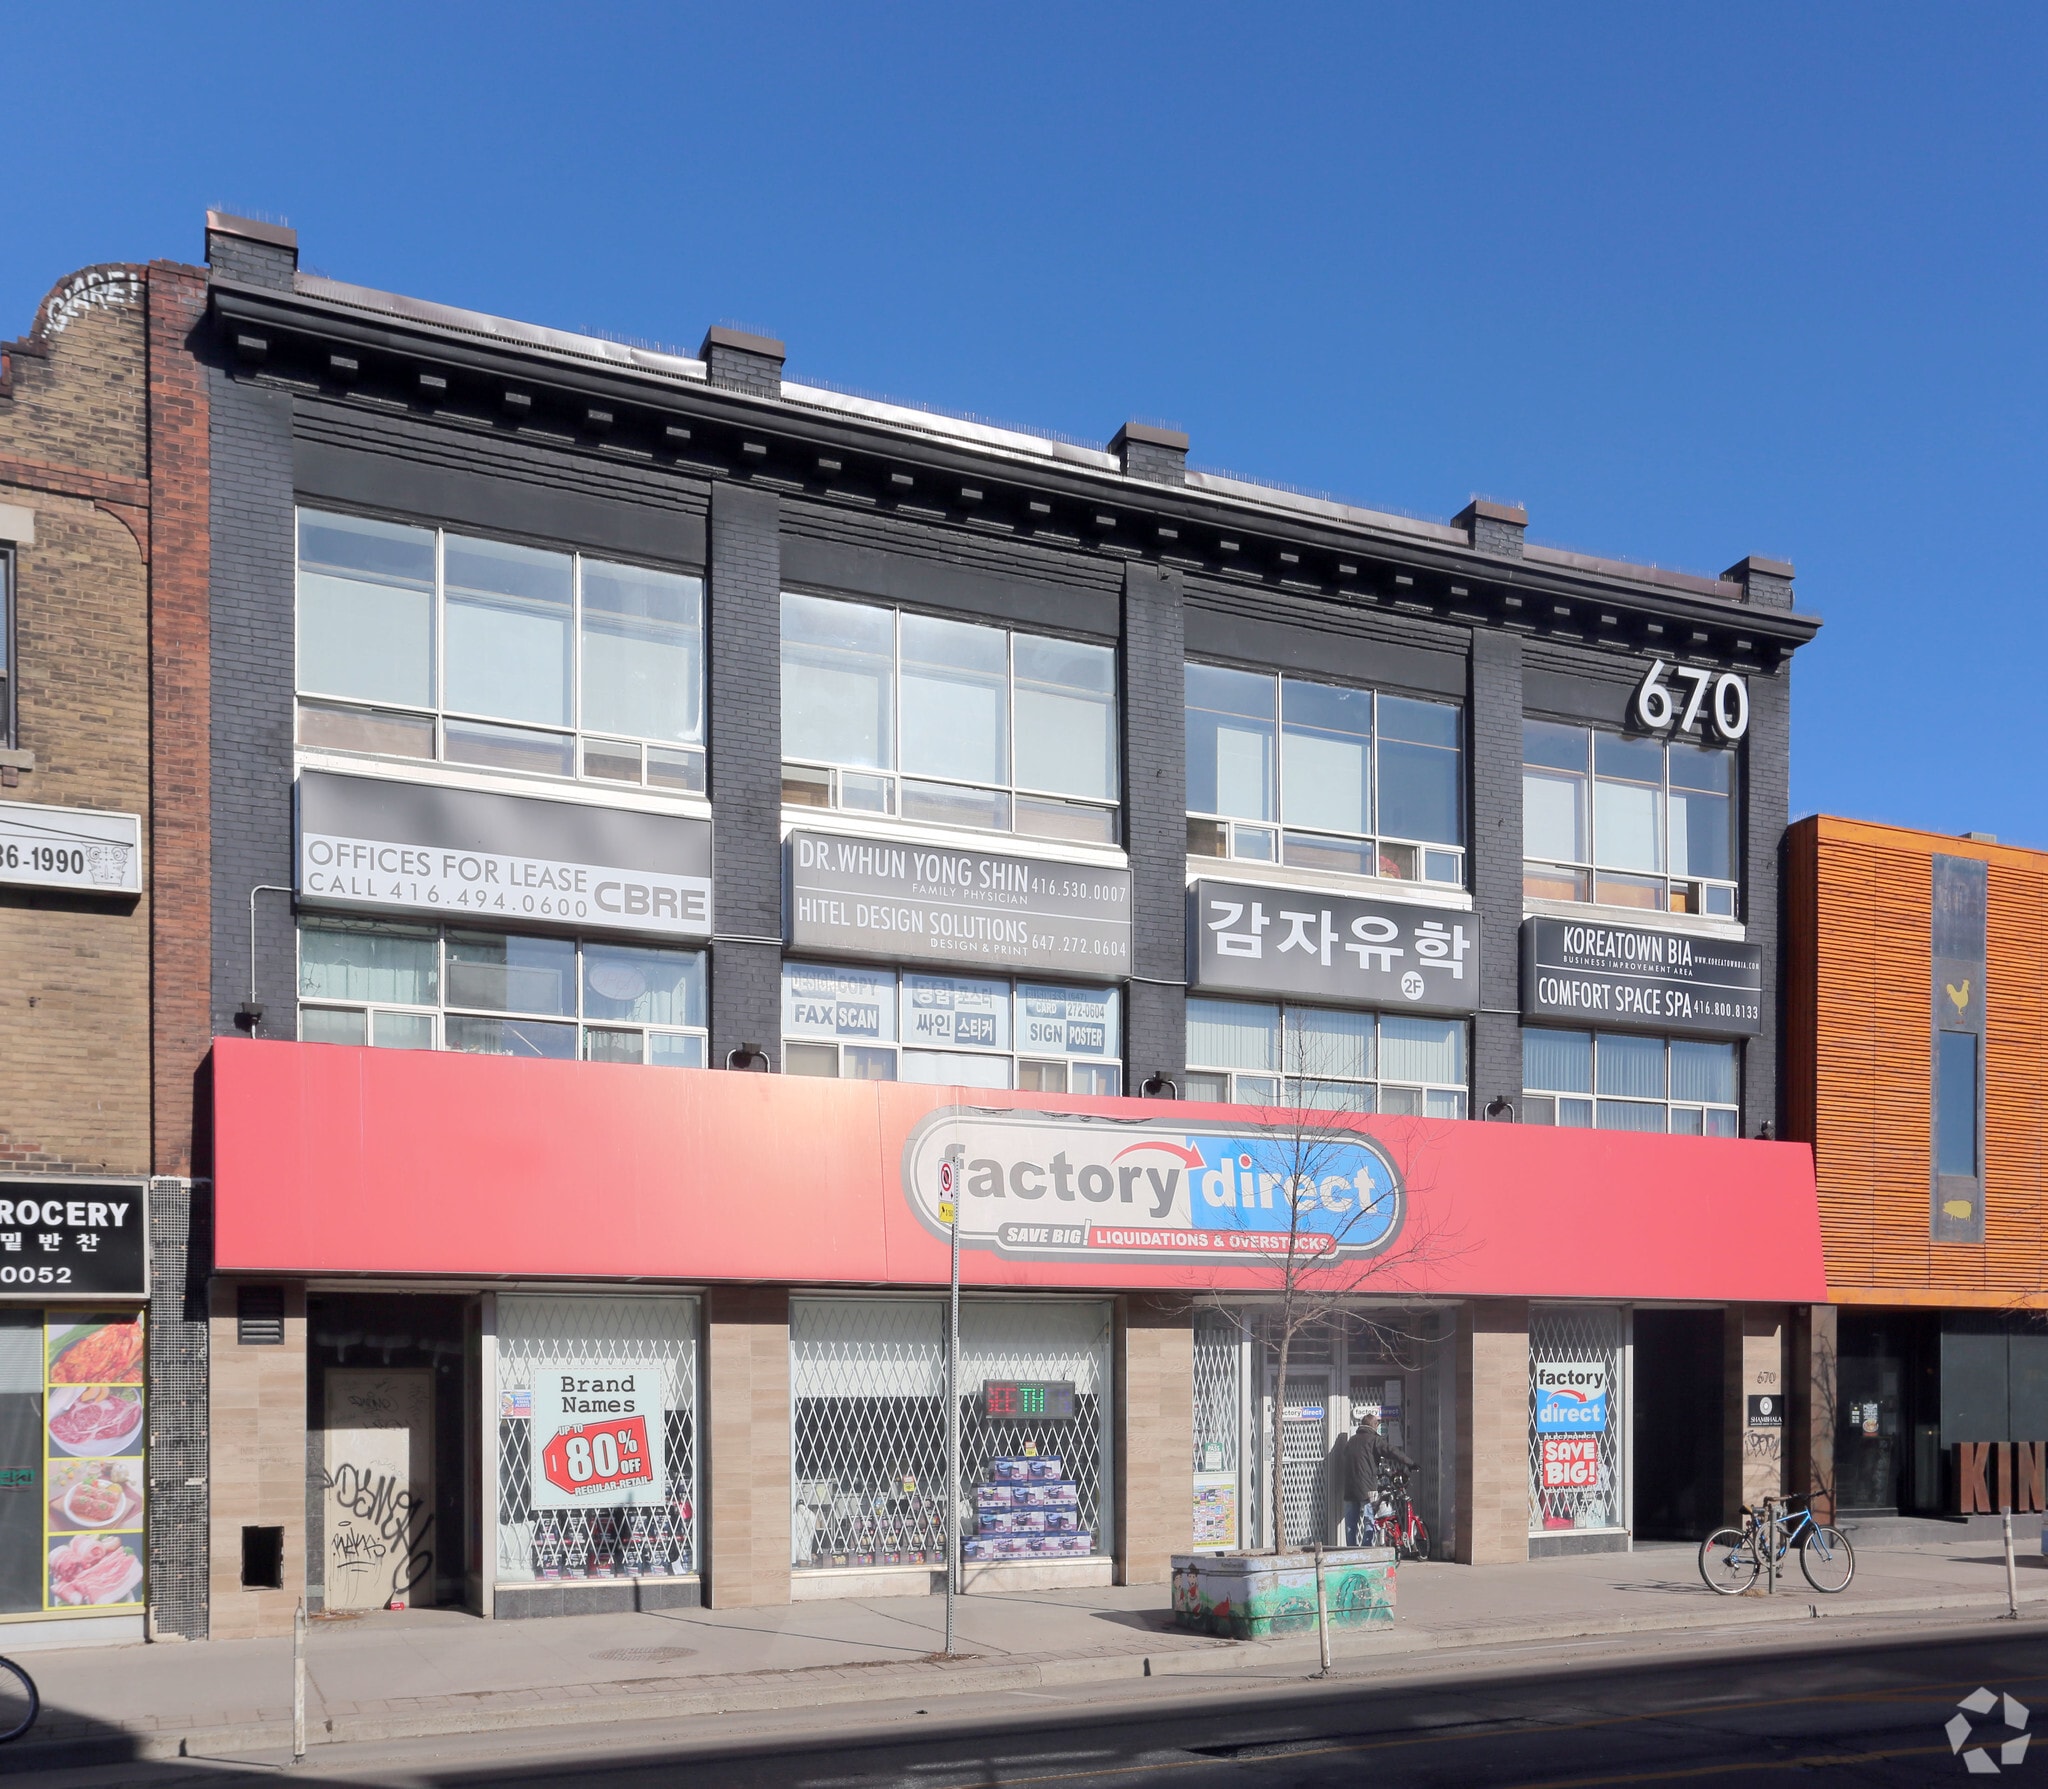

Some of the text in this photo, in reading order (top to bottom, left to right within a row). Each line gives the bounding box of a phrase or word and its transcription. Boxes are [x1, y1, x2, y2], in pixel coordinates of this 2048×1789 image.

[1639, 658, 1749, 739] 670
[308, 840, 587, 893] OFFICES FOR LEASE
[913, 852, 972, 887] YONG
[979, 861, 1028, 893] SHIN
[1032, 878, 1126, 902] 416.530.0007
[309, 872, 587, 918] CALL 416.494.0600
[594, 881, 706, 921] CBRE
[912, 883, 1028, 905] FAMILY PHYSICIAN
[799, 897, 1126, 956] HITEL DESIGN SOLUTIONS 647.272.0604
[930, 938, 1028, 956] DESIGN & PRINT
[1207, 900, 1471, 979] 감자유학
[1563, 926, 1663, 963] KOREATOWN
[1668, 938, 1693, 967] BIA
[1563, 955, 1693, 977] BUSINESS IMPROVEMENT AREA
[791, 971, 836, 993] DESIGN
[1403, 978, 1422, 994] 2F
[1027, 989, 1065, 1003] BUSINESS
[1538, 977, 1758, 1019] COMFORT SPACE SPA 416.800.8133
[794, 1003, 878, 1029] FAX SCAN
[1036, 1002, 1105, 1019] CARD 272-0604
[916, 1013, 993, 1042] 싸인 스티커
[1030, 1023, 1103, 1047] SIGN POSTER
[1202, 1153, 1378, 1214] direct
[1006, 1218, 1330, 1251] SAVE BIG! LIQUIDATIONS & OVERSTOCKS
[0, 1266, 72, 1284] 0052
[560, 1375, 636, 1393] Brand
[1538, 1369, 1604, 1389] factory
[1756, 1371, 1777, 1385] 670
[561, 1396, 636, 1413] Names
[1282, 1408, 1322, 1417] ctory direct
[1540, 1402, 1601, 1423] direct
[558, 1423, 584, 1436] UP TO
[565, 1429, 641, 1483] 80% OFF
[1545, 1441, 1596, 1462] SAVE
[1545, 1460, 1596, 1485] BIG!
[574, 1475, 650, 1497] REGULAR RETAIL
